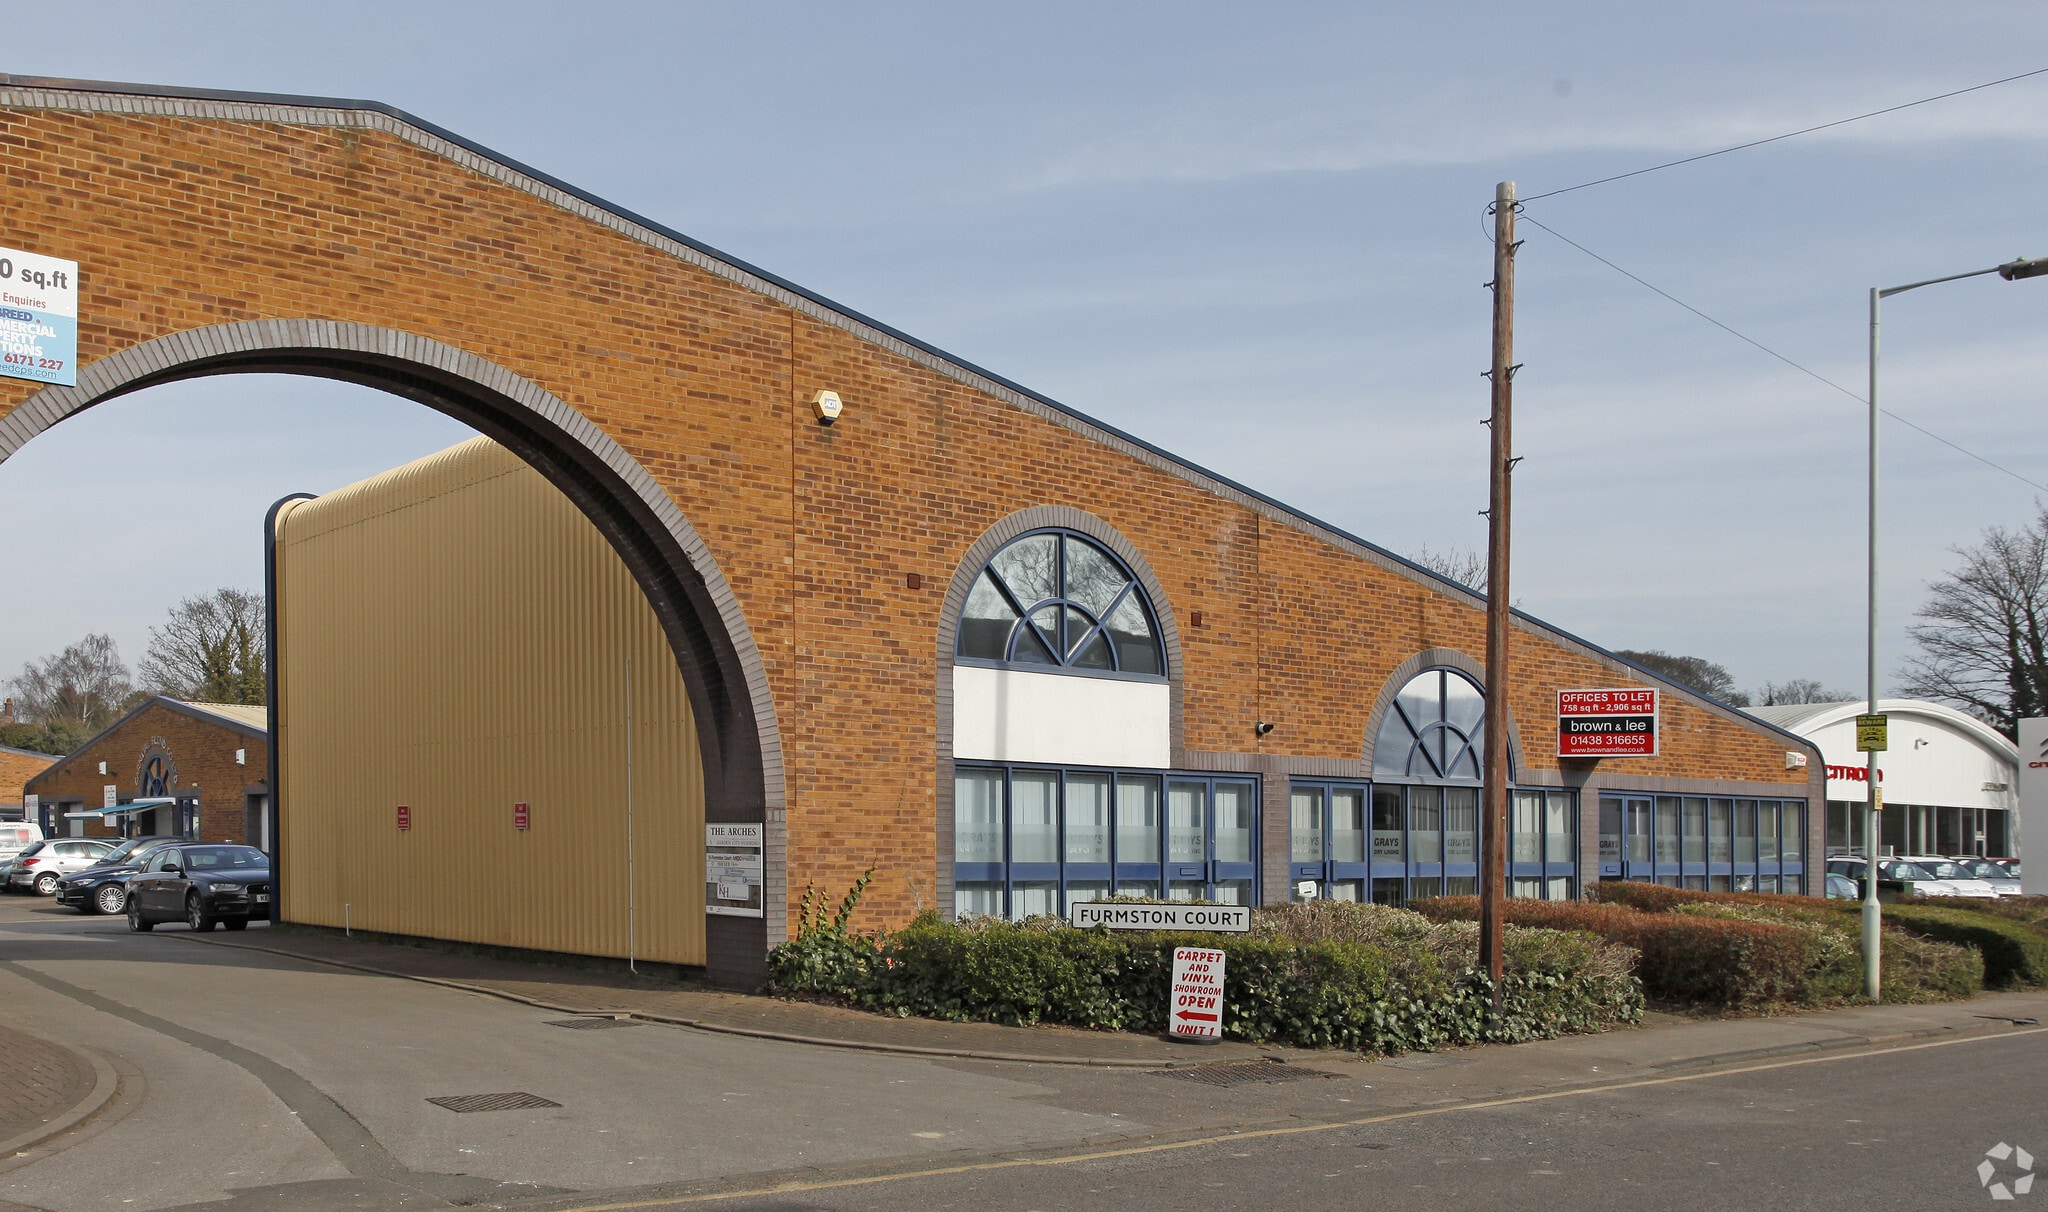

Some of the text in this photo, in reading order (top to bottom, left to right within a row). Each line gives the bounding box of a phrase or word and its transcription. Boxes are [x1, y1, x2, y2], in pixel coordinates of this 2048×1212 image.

[21, 268, 68, 290] sq.ft
[3, 292, 47, 309] Enquiries
[0, 308, 33, 322] REED
[4, 352, 64, 371] 6171 227
[0, 364, 57, 379] edcps.com
[1562, 692, 1652, 703] OFFICES TO LET
[1563, 704, 1578, 712] 758
[1580, 705, 1591, 713] sq
[1606, 703, 1629, 712] 2,906
[1631, 704, 1642, 712] sq
[1644, 703, 1651, 711] ft
[1571, 720, 1646, 732] brown & lee
[1570, 735, 1646, 745] 01438 316655
[710, 827, 757, 836] THE ARCHES
[1374, 838, 1399, 847] GRAYS
[1447, 837, 1471, 847] GRAYS
[1080, 909, 1243, 926] FURMSTON COURT
[1176, 950, 1223, 963] CARPET
[1188, 963, 1209, 973] AND
[1181, 973, 1215, 984] VINYL
[1174, 984, 1221, 996] SHOWROOM
[1178, 995, 1216, 1009] OPEN
[1176, 1024, 1215, 1037] UNIT 1
